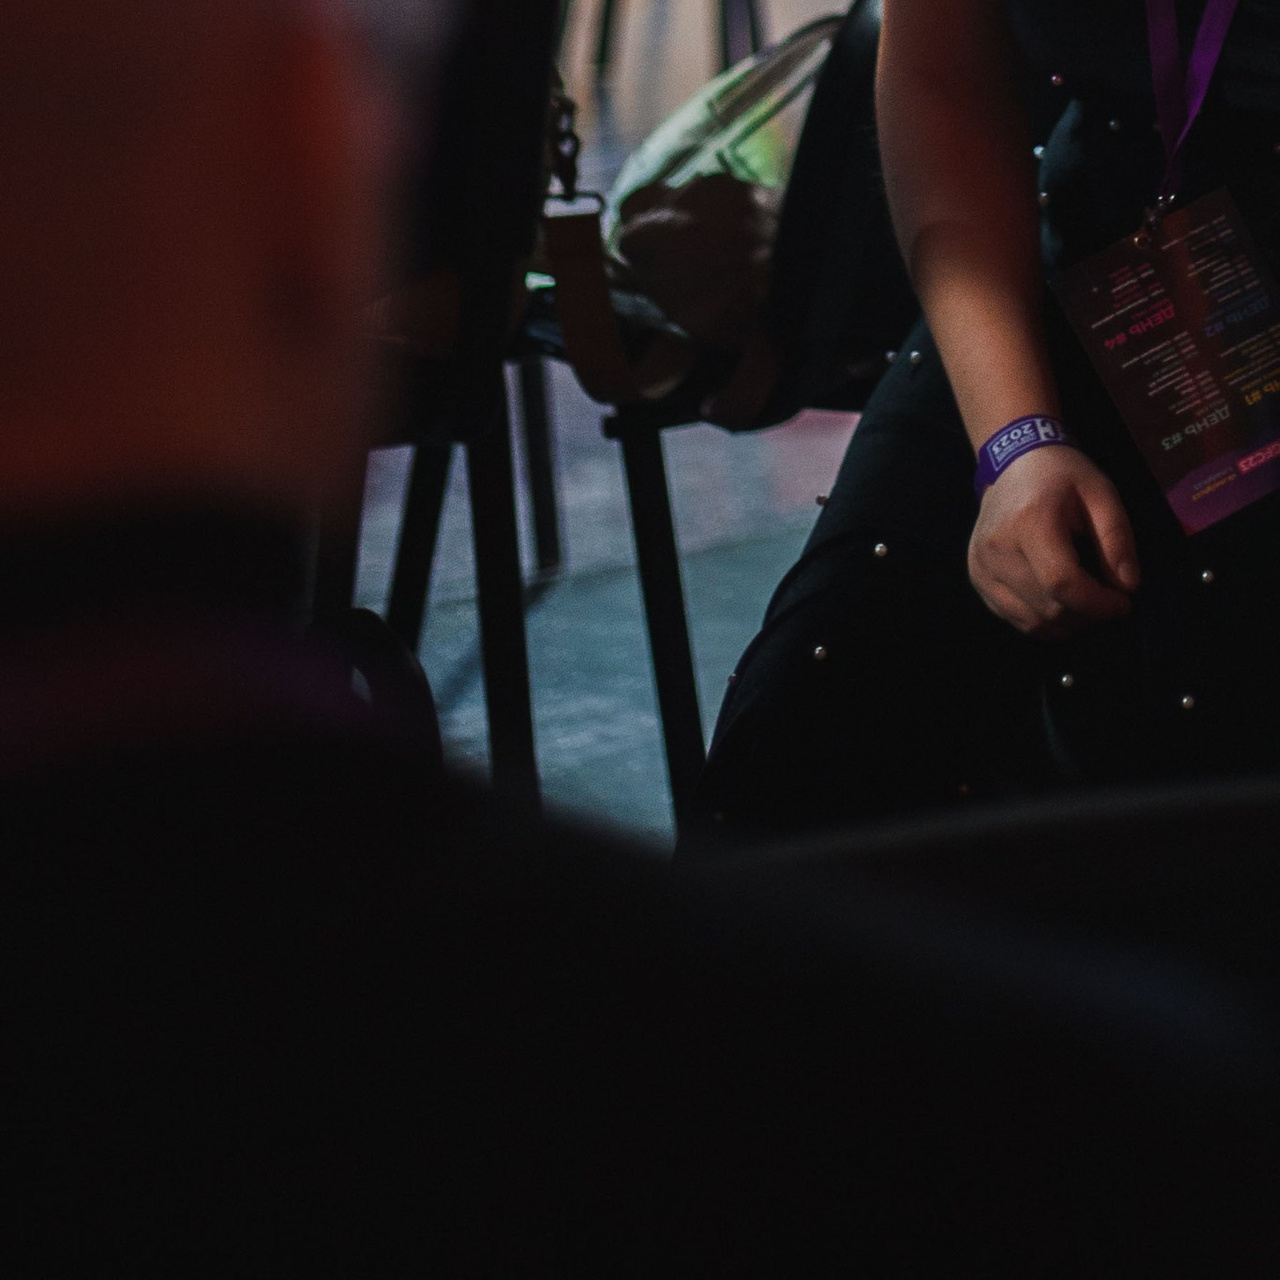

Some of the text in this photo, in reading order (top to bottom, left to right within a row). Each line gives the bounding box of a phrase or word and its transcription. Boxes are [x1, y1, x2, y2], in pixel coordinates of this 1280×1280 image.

[1128, 302, 1176, 335] ДЕНЬ
[1225, 294, 1270, 326] ДЕНЬ
[1103, 332, 1127, 350] #4
[1184, 404, 1231, 437] ДЕНЬ
[991, 422, 1033, 455] 2023
[1161, 430, 1184, 450] #3
